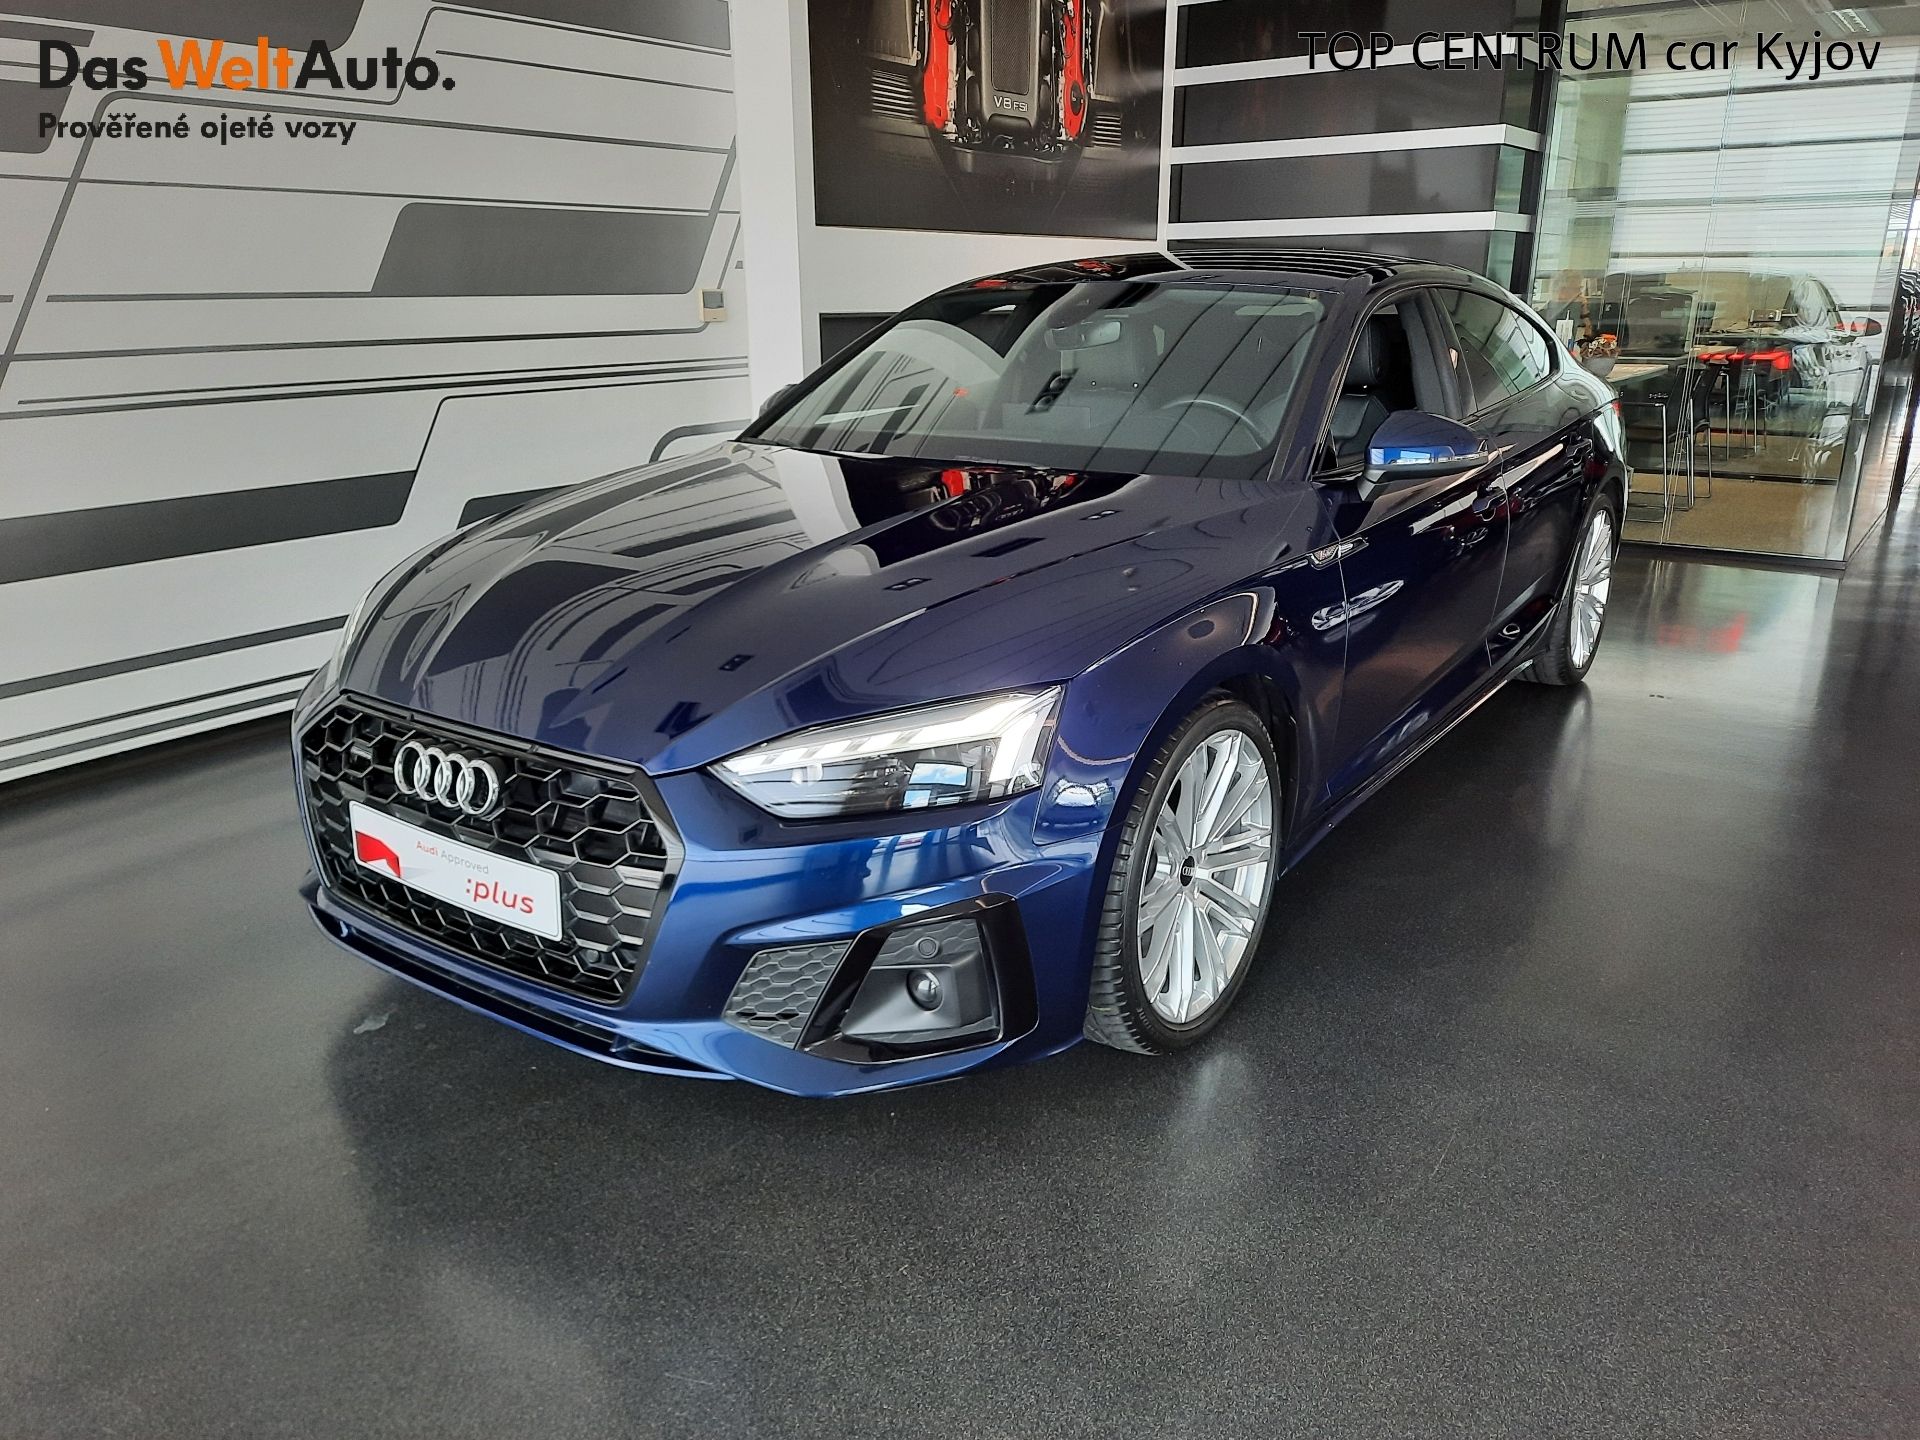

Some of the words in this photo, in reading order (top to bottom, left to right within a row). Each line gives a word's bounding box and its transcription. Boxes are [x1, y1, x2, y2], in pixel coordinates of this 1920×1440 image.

[993, 95, 1012, 109] V8
[1013, 101, 1028, 112] FSI
[416, 841, 438, 856] Audi
[441, 850, 489, 874] Approved
